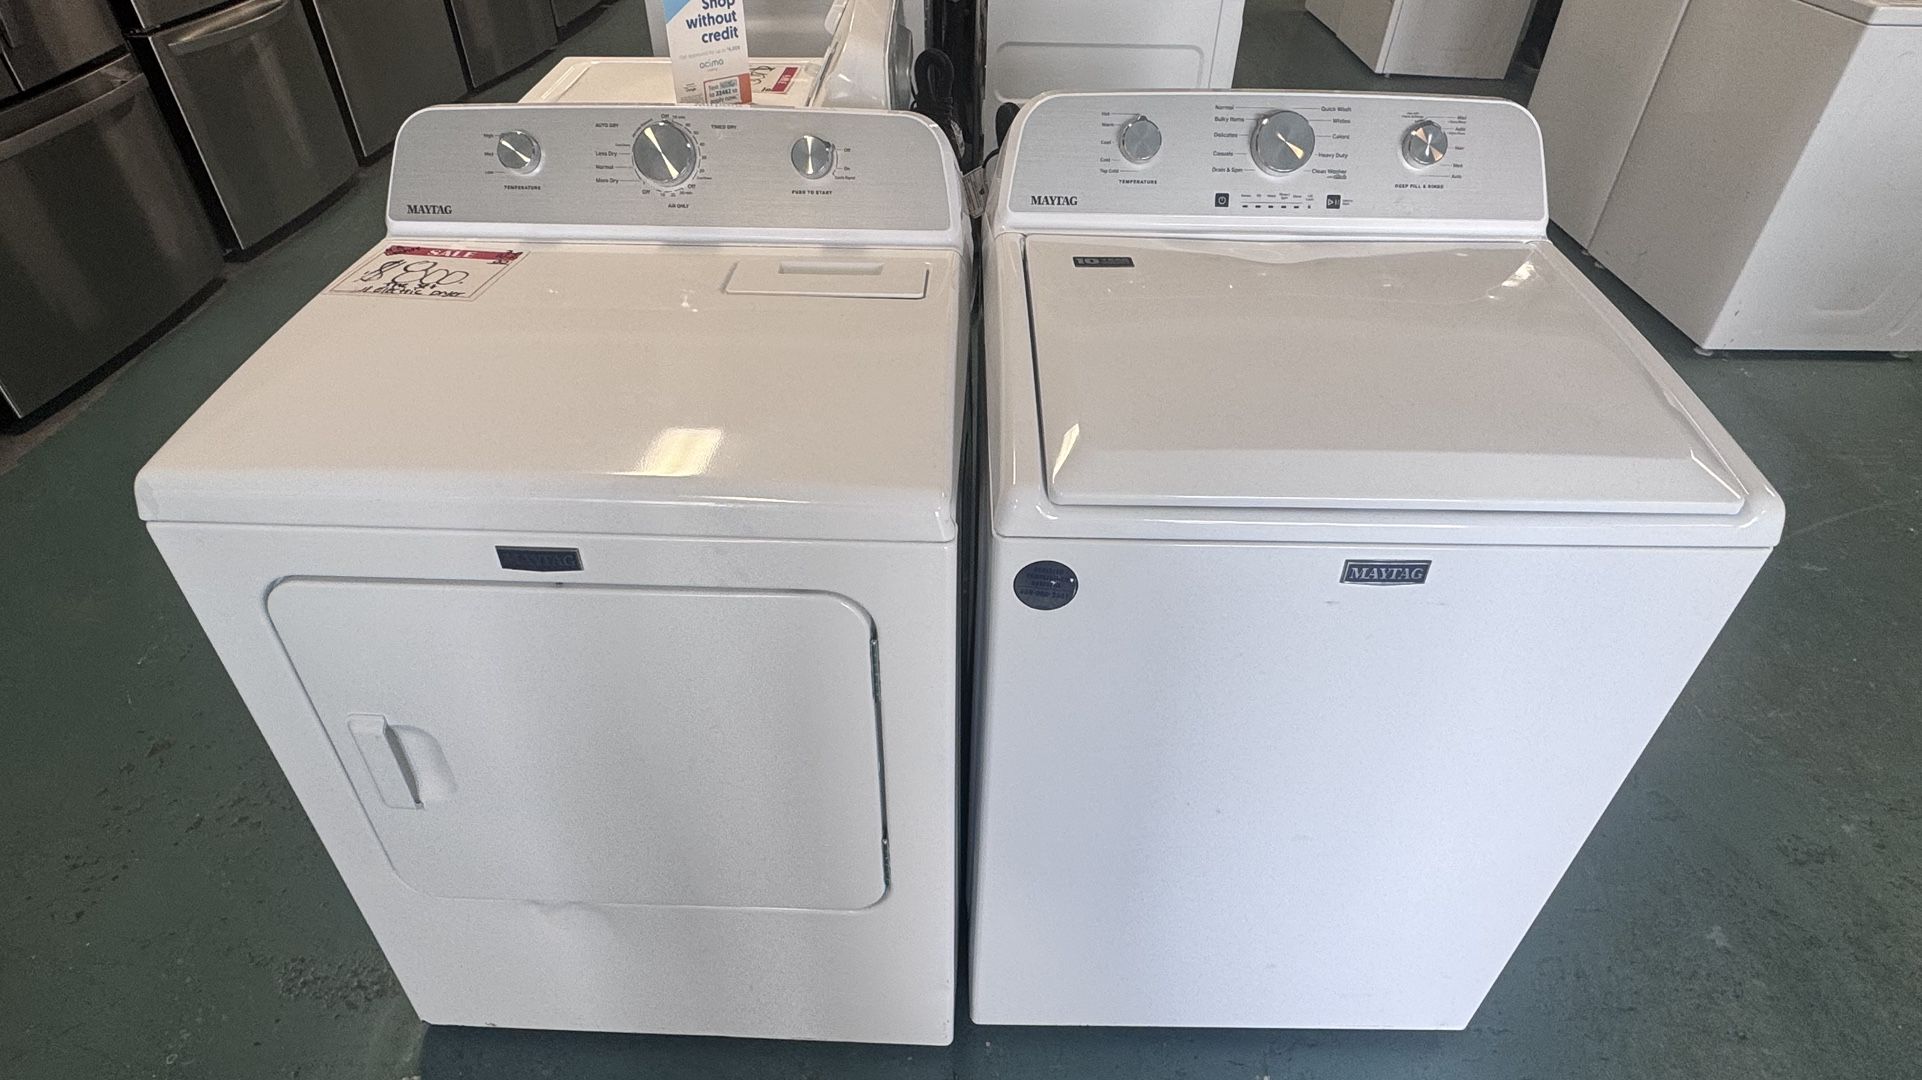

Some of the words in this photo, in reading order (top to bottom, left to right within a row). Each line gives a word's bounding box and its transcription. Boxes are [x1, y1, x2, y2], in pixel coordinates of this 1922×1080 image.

[686, 10, 737, 30] without
[702, 26, 738, 44] credit
[699, 58, 724, 69] acima
[1031, 196, 1078, 206] MAYTAG
[407, 204, 452, 215] MAYTAG
[1349, 567, 1424, 580] MAYTAG
